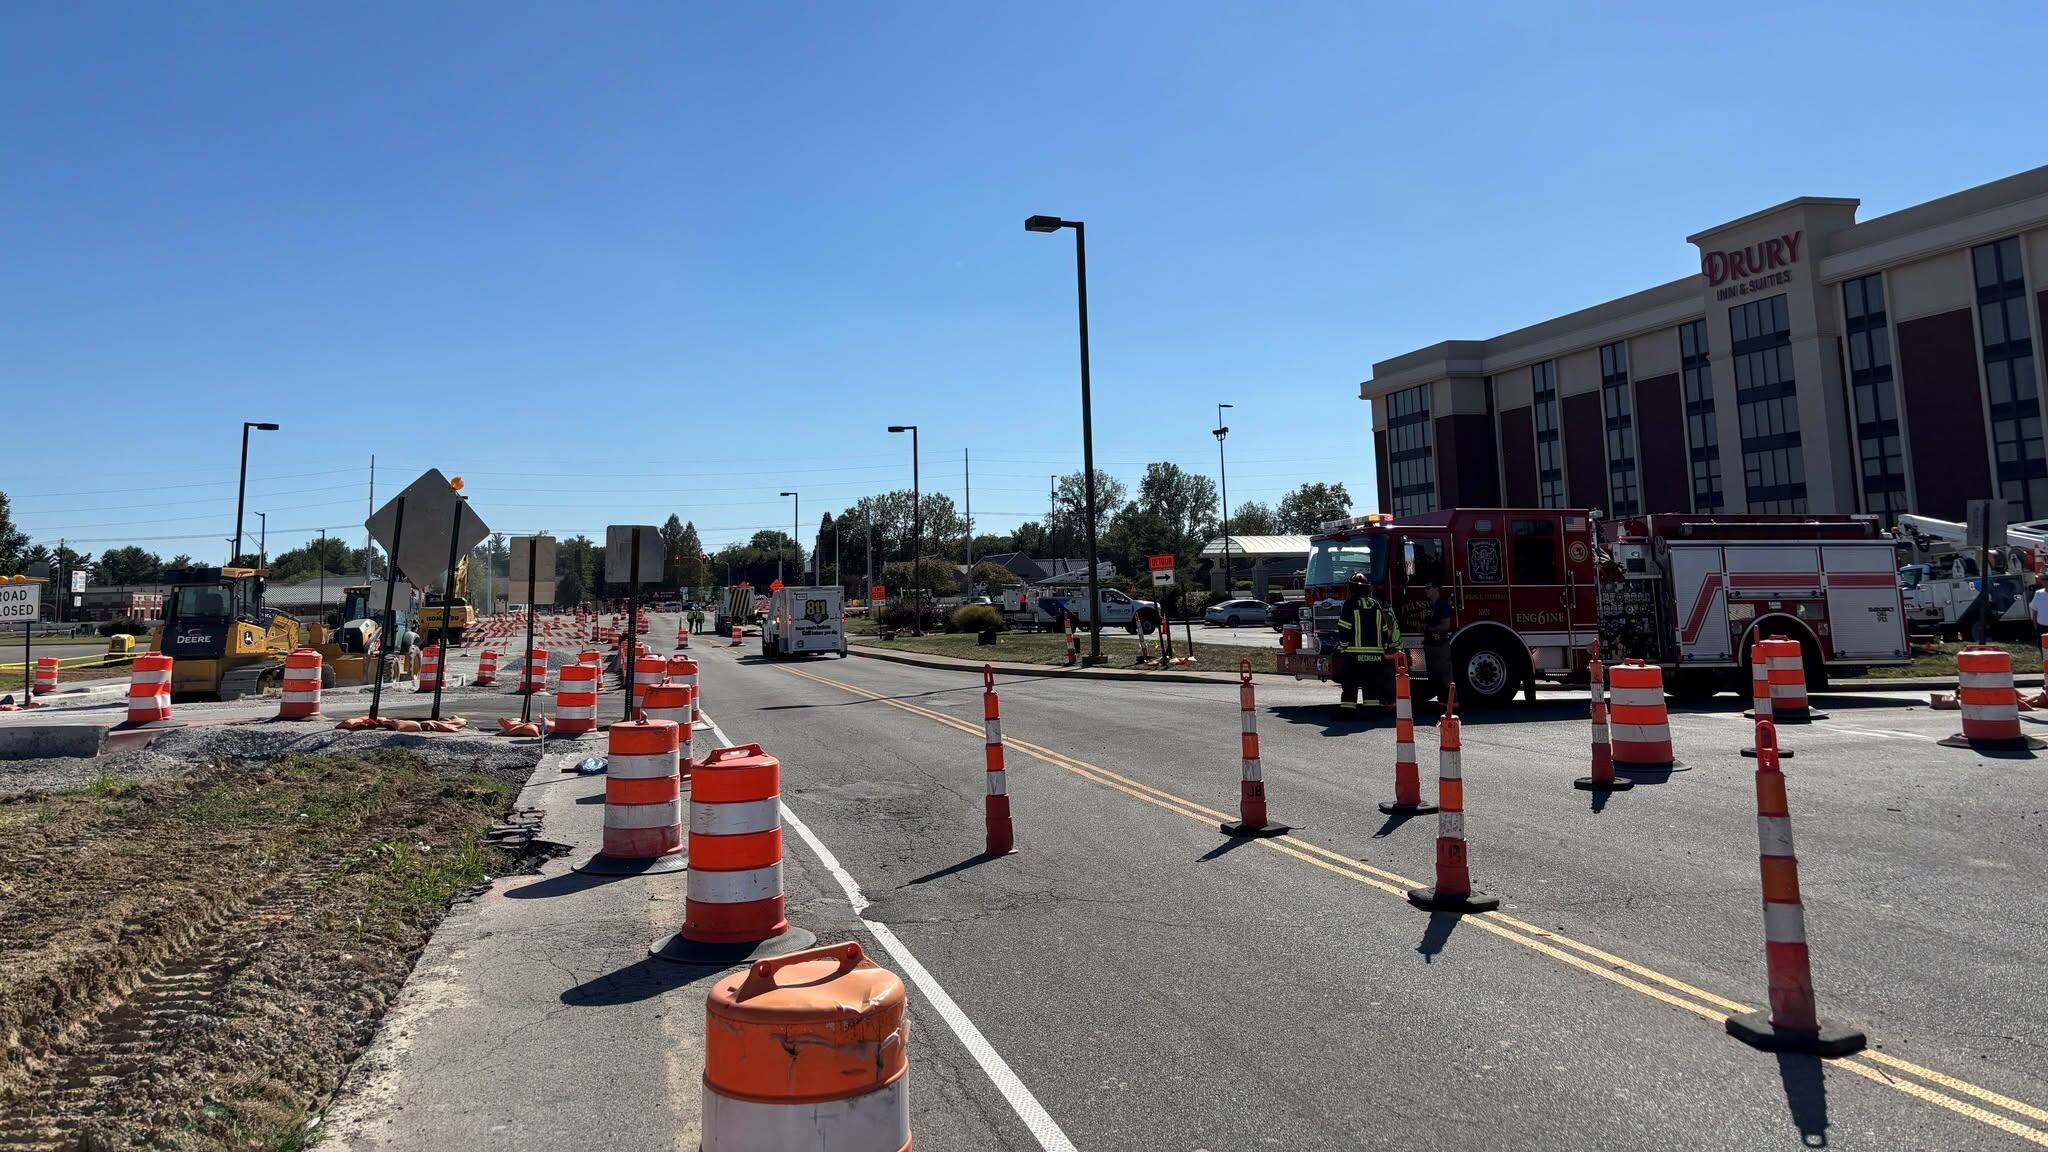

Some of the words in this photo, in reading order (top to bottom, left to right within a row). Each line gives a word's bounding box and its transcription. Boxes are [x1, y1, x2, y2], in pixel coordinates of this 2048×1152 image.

[1702, 230, 1803, 288] DRURY
[1716, 286, 1739, 302] INN
[1739, 283, 1748, 296] &
[1748, 270, 1793, 294] SUITES
[0, 589, 27, 602] OAD
[0, 604, 34, 617] OSED
[806, 600, 827, 615] 811
[176, 635, 213, 644] DEERE
